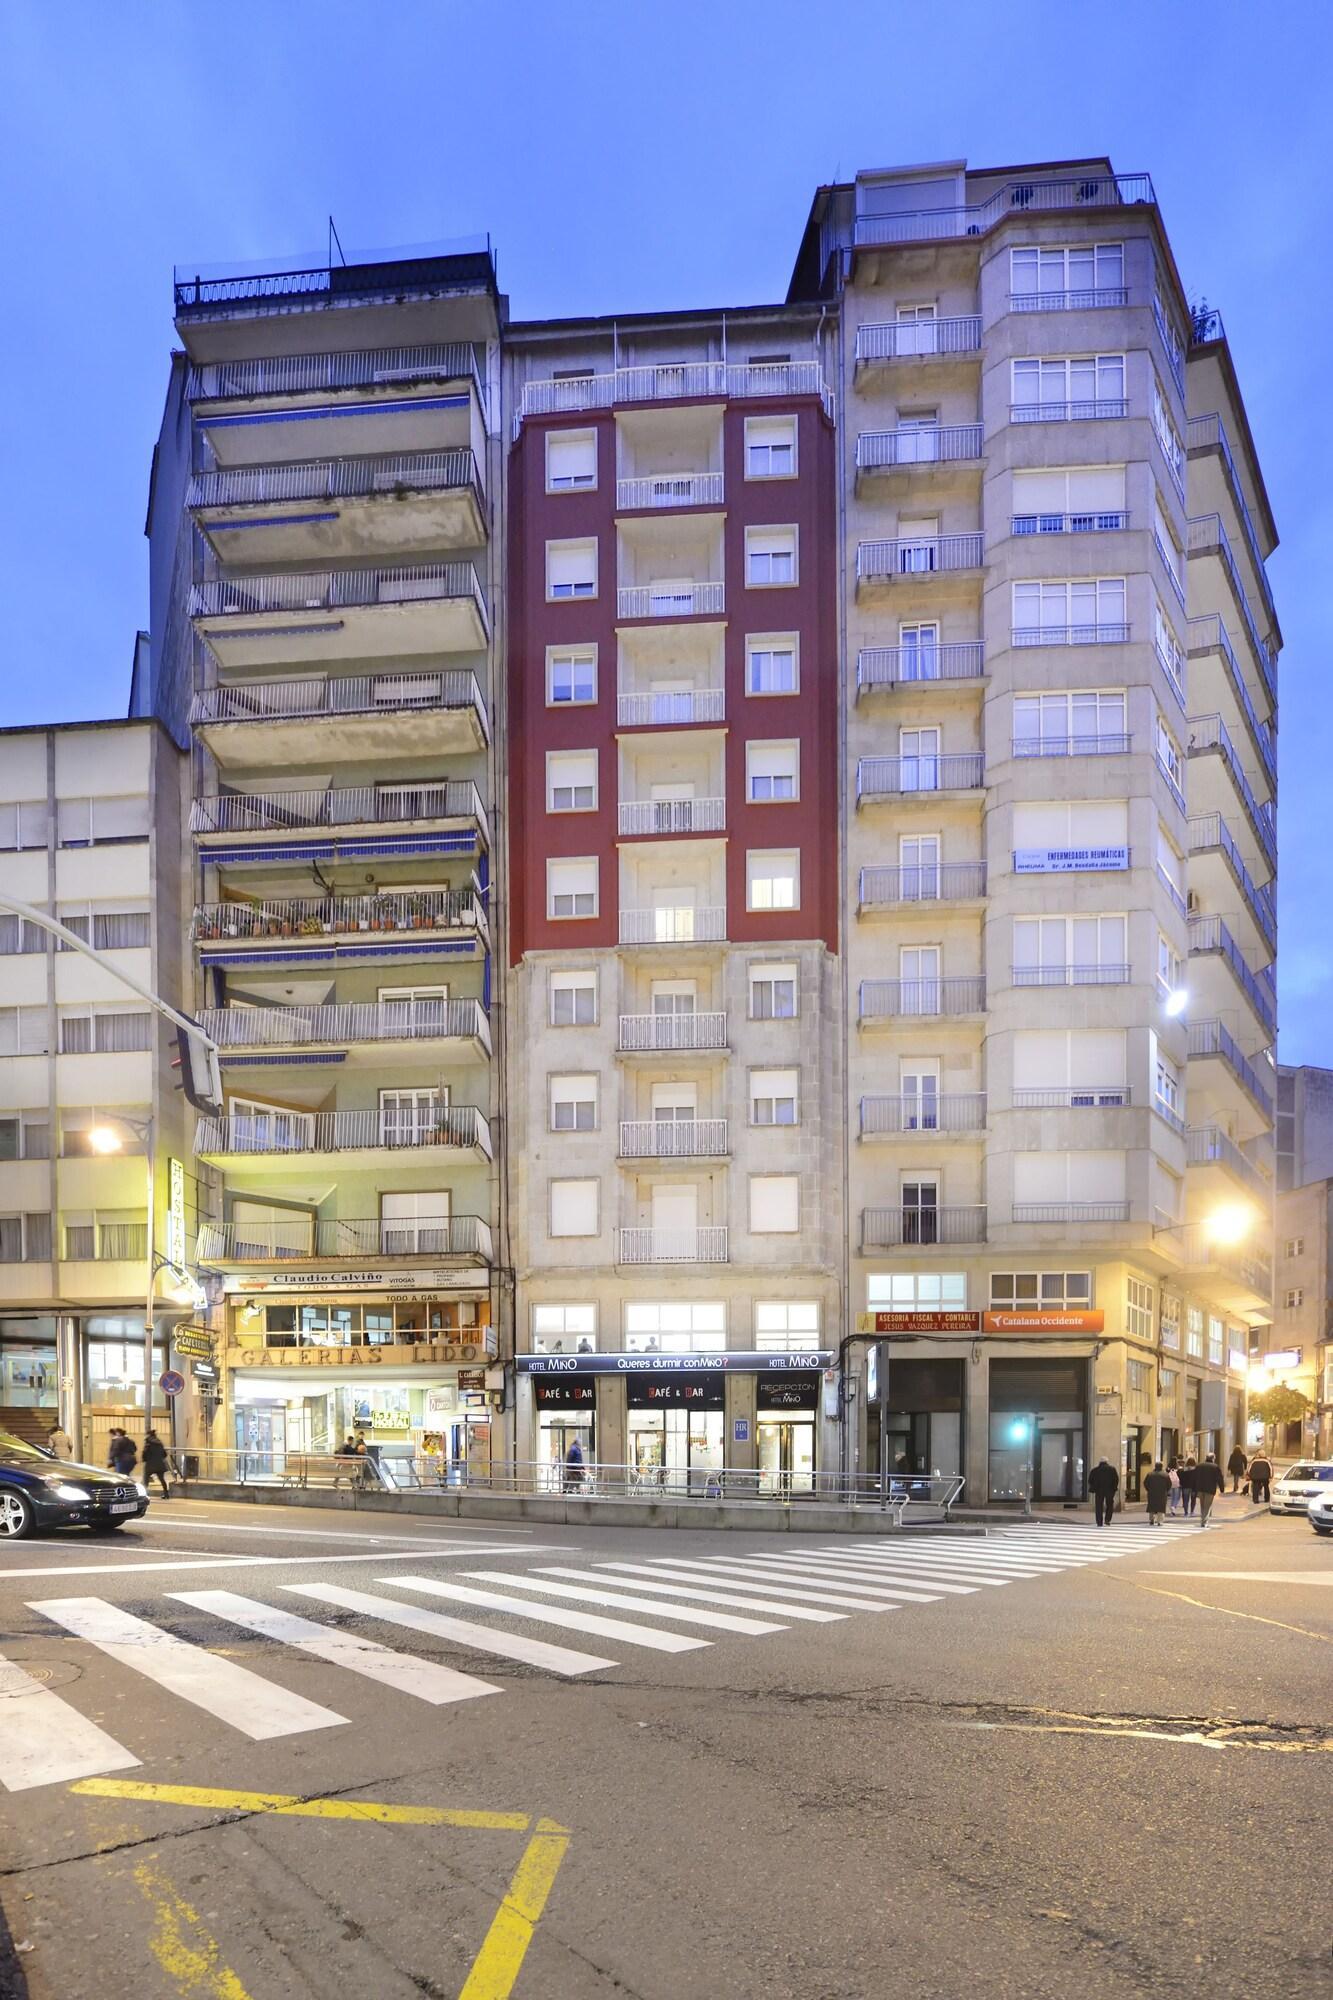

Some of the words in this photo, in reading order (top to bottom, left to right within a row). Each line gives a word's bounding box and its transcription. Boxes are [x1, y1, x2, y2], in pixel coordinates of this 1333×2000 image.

[1047, 851, 1089, 861] ENFERMEDADES
[1091, 848, 1125, 859] REUMÁTICAS
[172, 1161, 183, 1265] HOSTAL
[273, 1274, 328, 1283] Claudio
[331, 1272, 382, 1282] Calviño
[880, 1314, 909, 1322] ASESORIA
[912, 1314, 934, 1322] FISCAL
[945, 1313, 976, 1322] CONTABLE
[1002, 1317, 1040, 1326] Catalana
[1041, 1317, 1084, 1325] Occidente
[908, 1322, 938, 1330] VAZQUEZ
[942, 1322, 971, 1330] PEREIRA
[241, 1347, 383, 1366] GALERIAS
[411, 1345, 477, 1363] LIDO
[528, 1362, 546, 1371] HOTEL
[617, 1358, 650, 1369] Queres
[653, 1357, 682, 1368] durmir
[769, 1359, 787, 1368] HOTEL
[539, 1388, 560, 1399] CAFÉ
[574, 1388, 592, 1399] BAR
[649, 1387, 671, 1398] CAFÉ
[685, 1387, 704, 1398] BAR
[735, 1423, 747, 1432] HR
